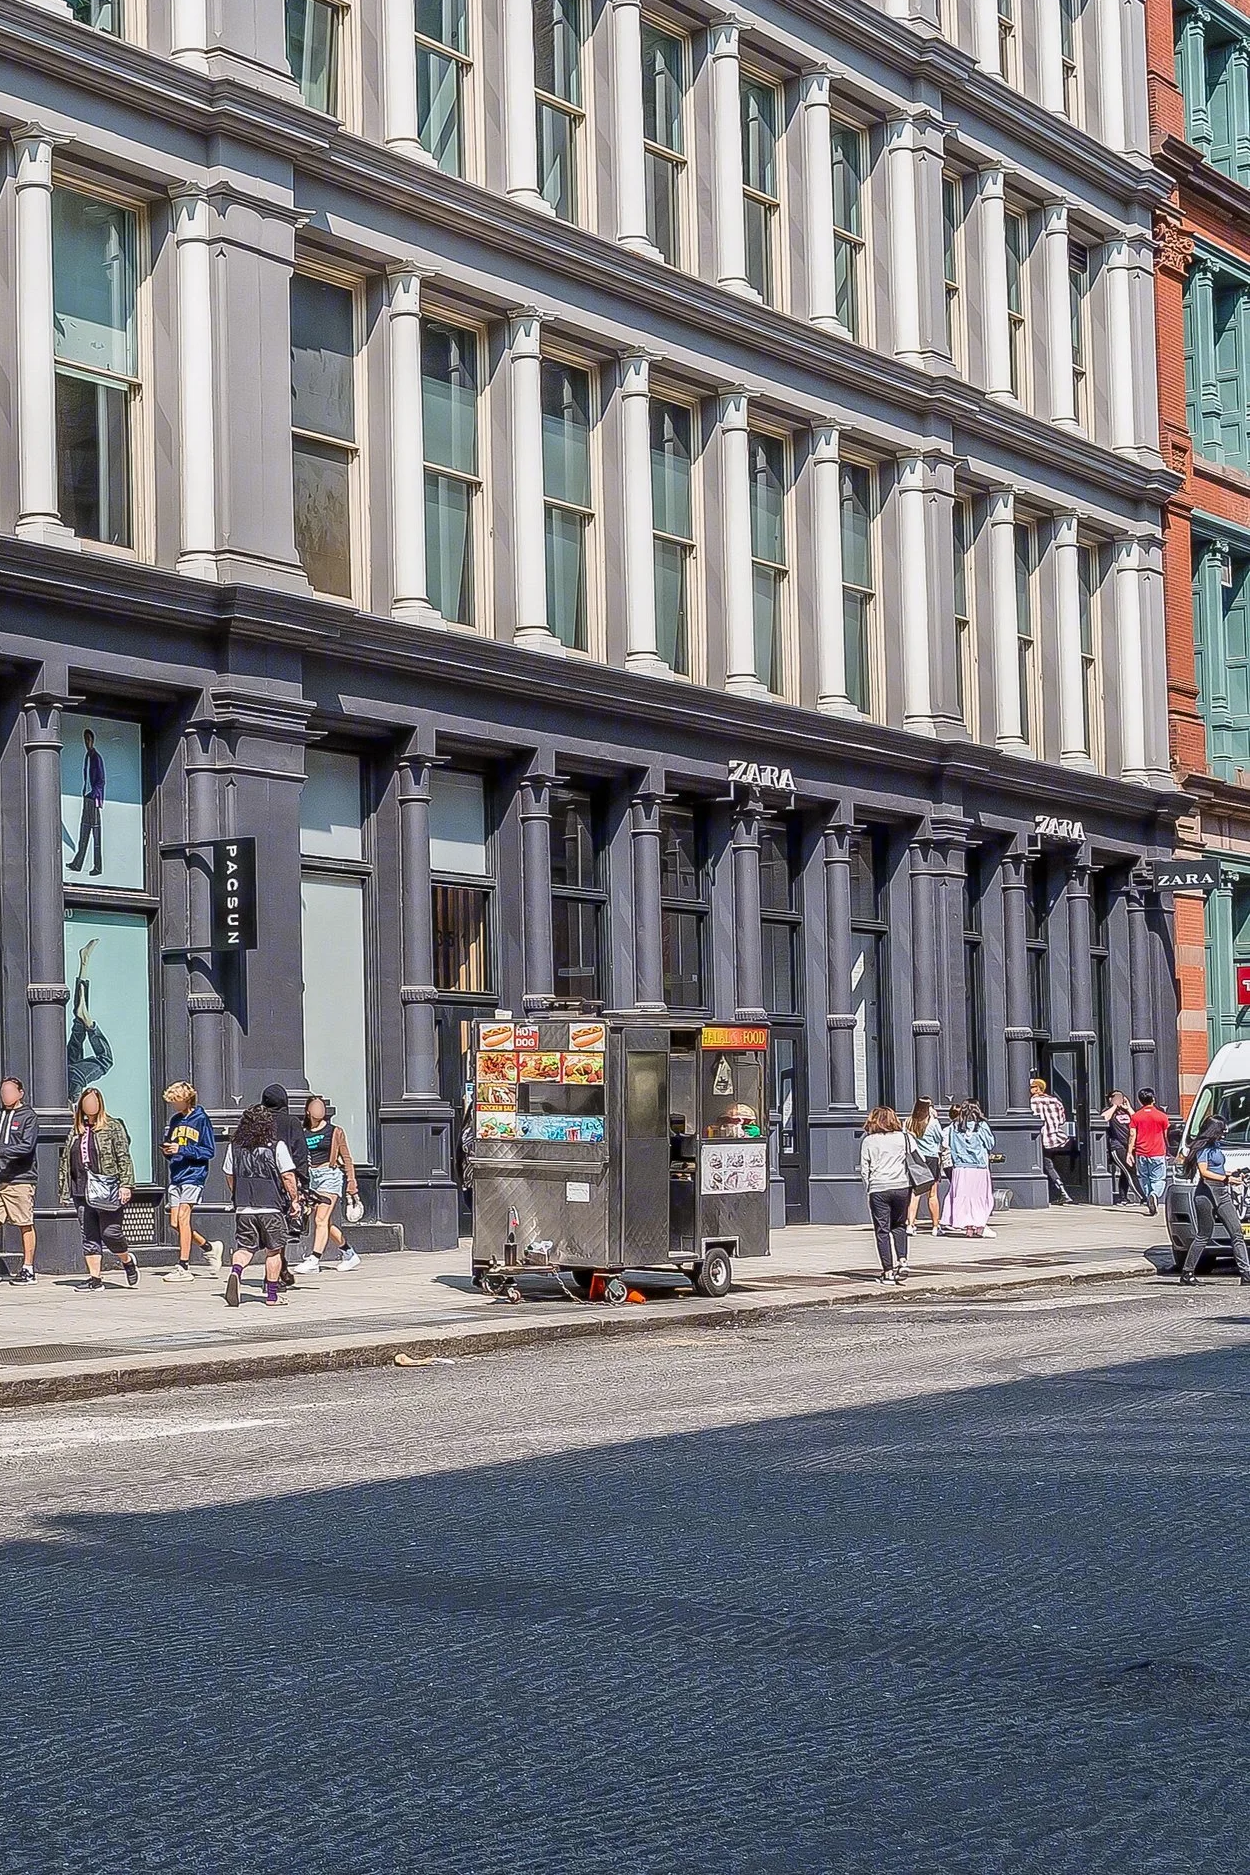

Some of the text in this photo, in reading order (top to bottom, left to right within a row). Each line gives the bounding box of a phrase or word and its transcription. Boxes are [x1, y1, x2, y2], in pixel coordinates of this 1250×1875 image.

[728, 759, 798, 790] ZARA
[1034, 815, 1087, 841] ZARA
[1157, 873, 1215, 886] ZARA
[226, 845, 240, 944] PACSUN
[515, 1026, 534, 1037] HOT
[743, 1030, 765, 1044] FOOD
[515, 1037, 535, 1048] DOG
